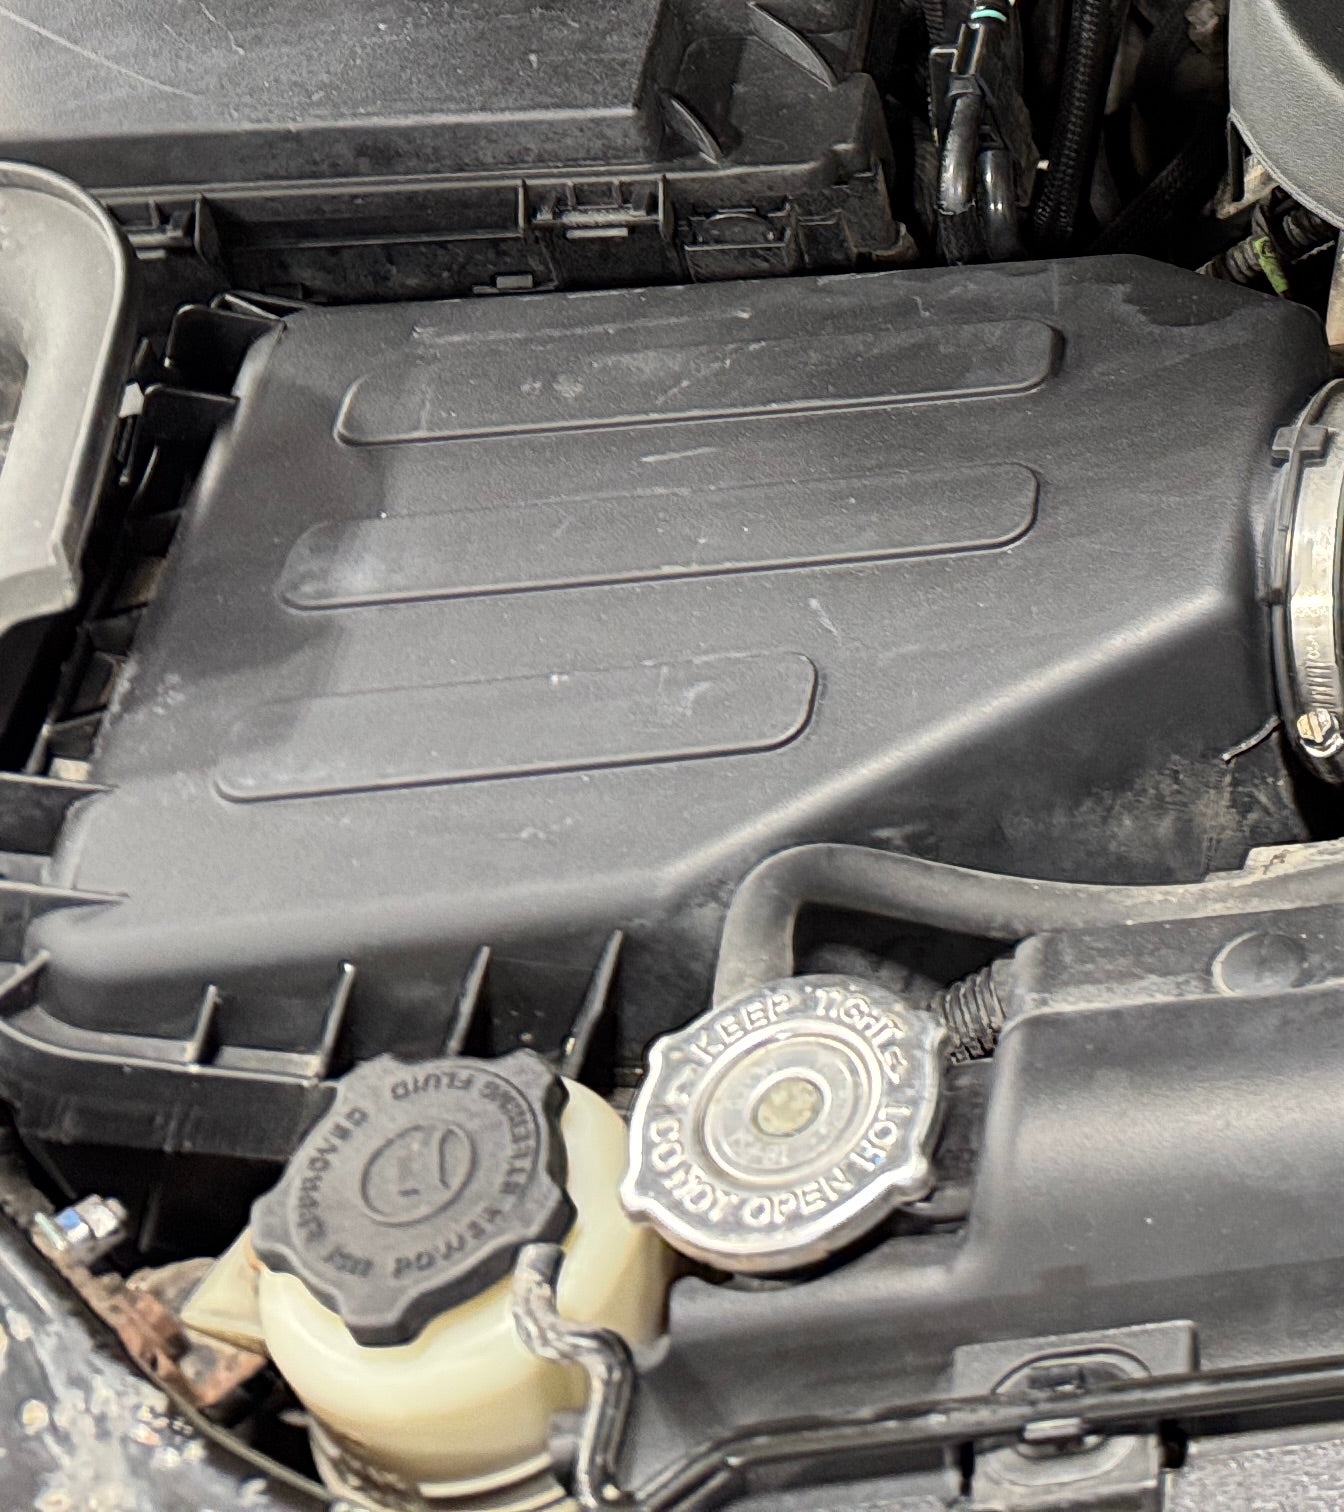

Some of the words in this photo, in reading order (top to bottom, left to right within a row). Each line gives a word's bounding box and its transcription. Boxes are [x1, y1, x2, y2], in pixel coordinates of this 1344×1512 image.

[689, 993, 792, 1065] KEEP
[391, 1070, 475, 1101] FLUID
[742, 1167, 855, 1226] OPEN
[393, 1203, 502, 1278] POWER
